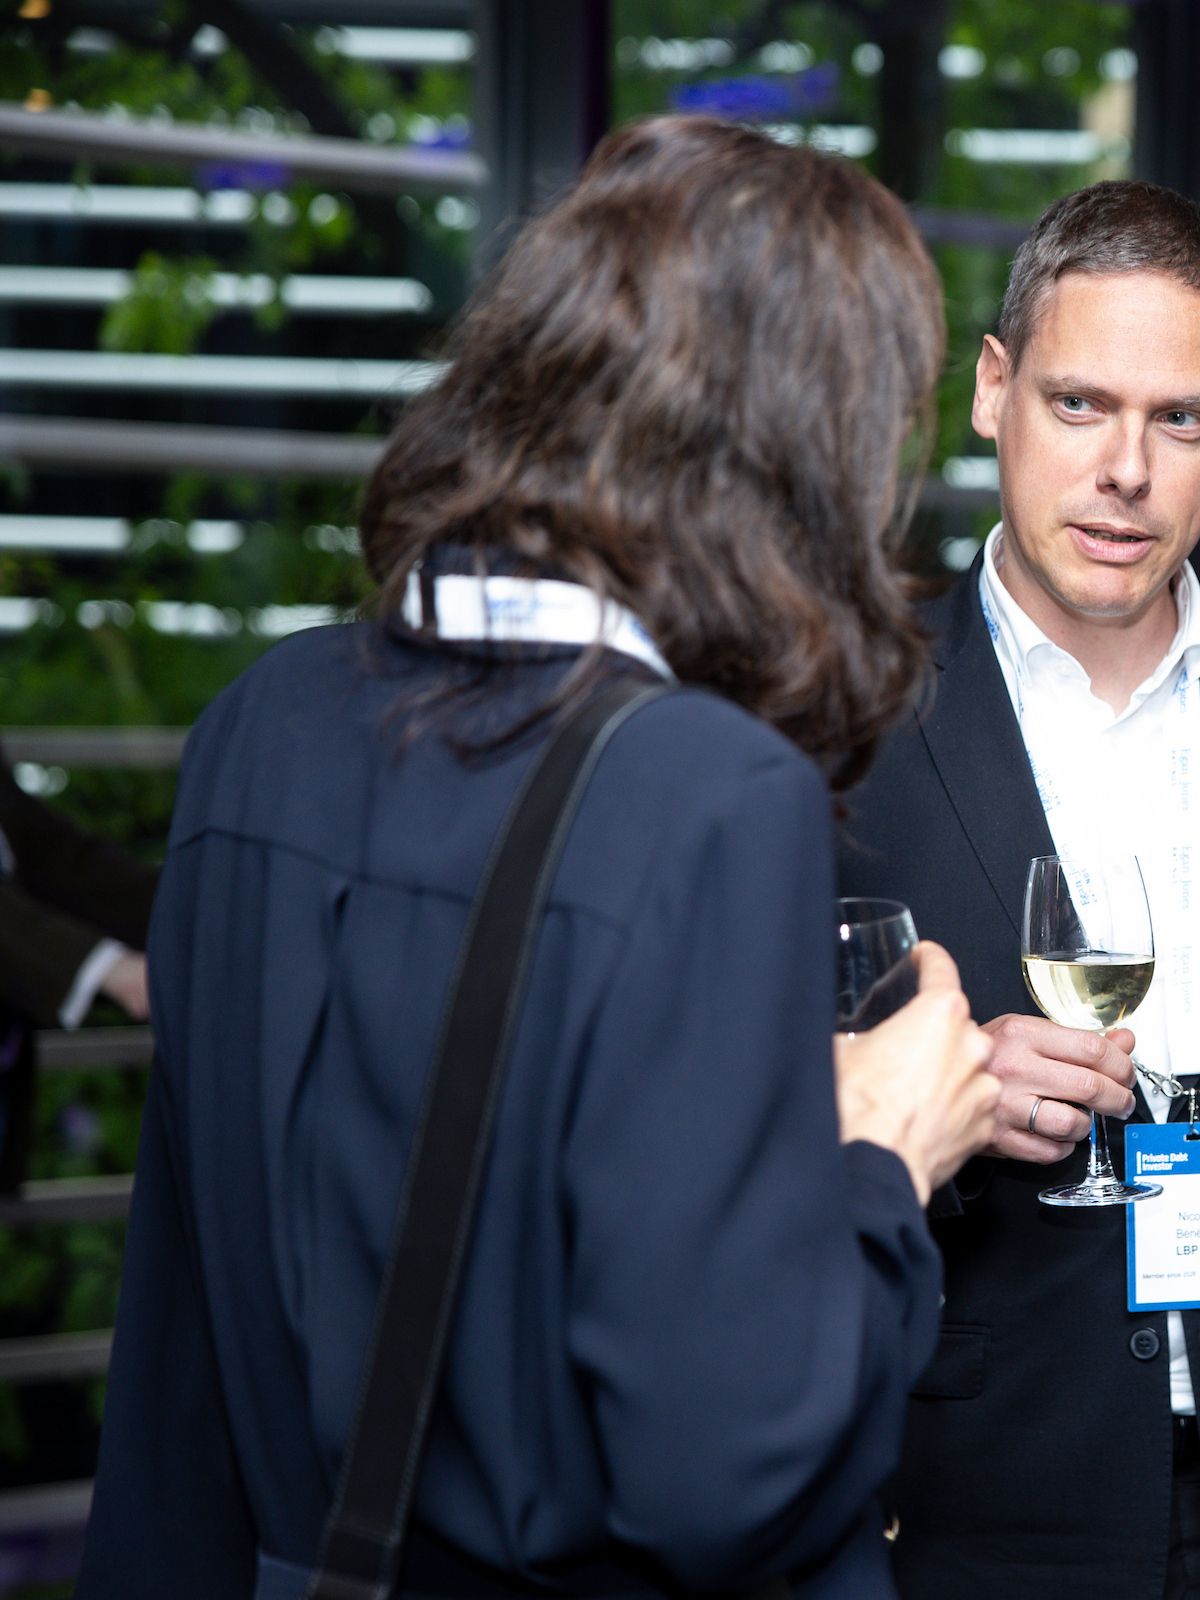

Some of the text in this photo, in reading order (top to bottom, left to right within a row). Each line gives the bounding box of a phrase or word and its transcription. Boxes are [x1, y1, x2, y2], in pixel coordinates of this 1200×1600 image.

[1142, 1152, 1188, 1163] Private Debt
[1176, 1245, 1198, 1256] LBP
